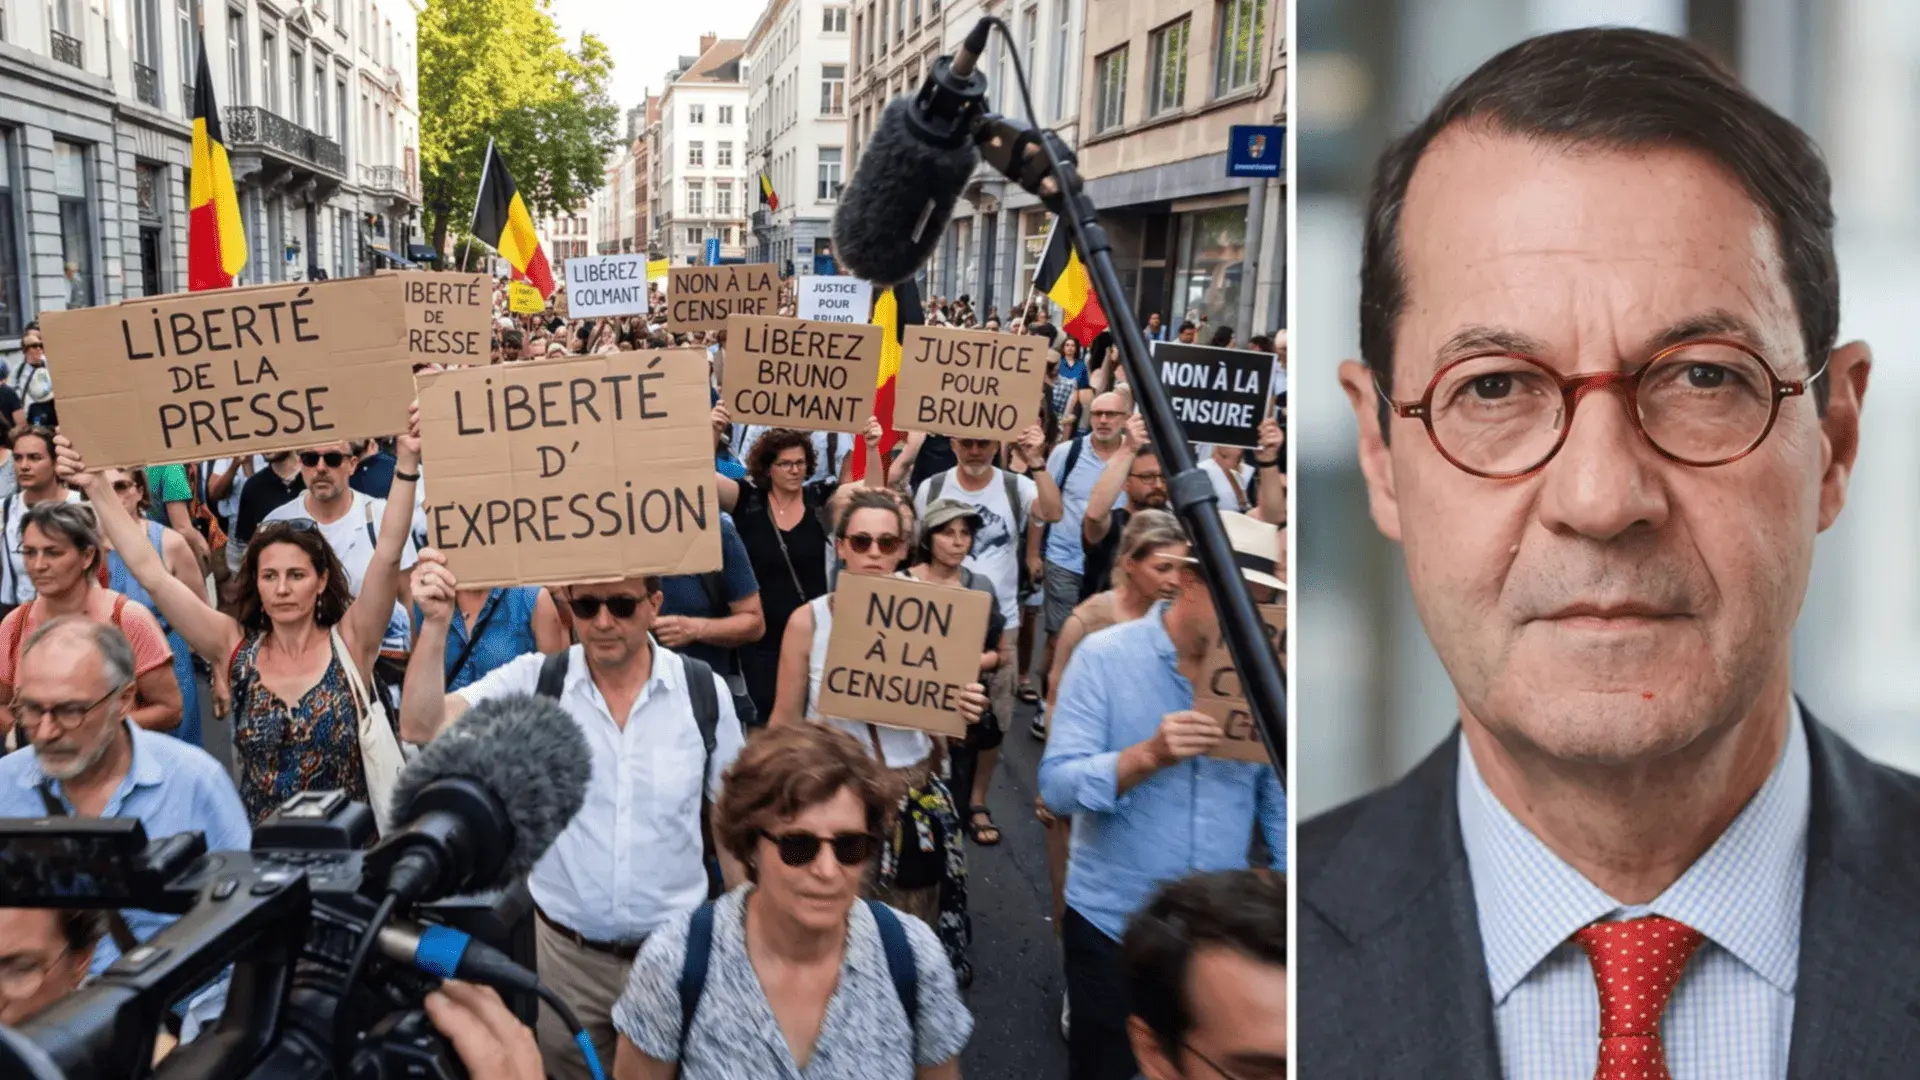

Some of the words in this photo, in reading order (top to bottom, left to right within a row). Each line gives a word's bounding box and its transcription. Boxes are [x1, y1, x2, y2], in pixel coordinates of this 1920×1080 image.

[574, 258, 637, 283] LIBÉREZ
[675, 273, 718, 294] NON
[726, 266, 740, 292] À
[747, 272, 772, 291] LA
[405, 277, 480, 306] IBERTÉ
[575, 286, 640, 306] COLMANT
[813, 283, 857, 294] JUSTICE
[818, 299, 850, 309] POUR
[424, 310, 444, 324] DE
[409, 329, 480, 355] RESSE
[168, 363, 215, 394] DE
[234, 356, 279, 387] LA
[758, 359, 848, 390] BRUNO
[941, 372, 1000, 397] POUR
[1161, 361, 1210, 389] NON
[1211, 361, 1228, 391] À
[1233, 368, 1259, 394] LA
[159, 387, 334, 448] PRESSE
[735, 389, 863, 422] COLMANT
[917, 396, 1018, 431] BRUNO
[1171, 397, 1255, 428] ENSURE
[866, 592, 953, 637] NON
[864, 630, 886, 663] À
[901, 642, 939, 672] LA
[827, 666, 960, 713] CENSURE
